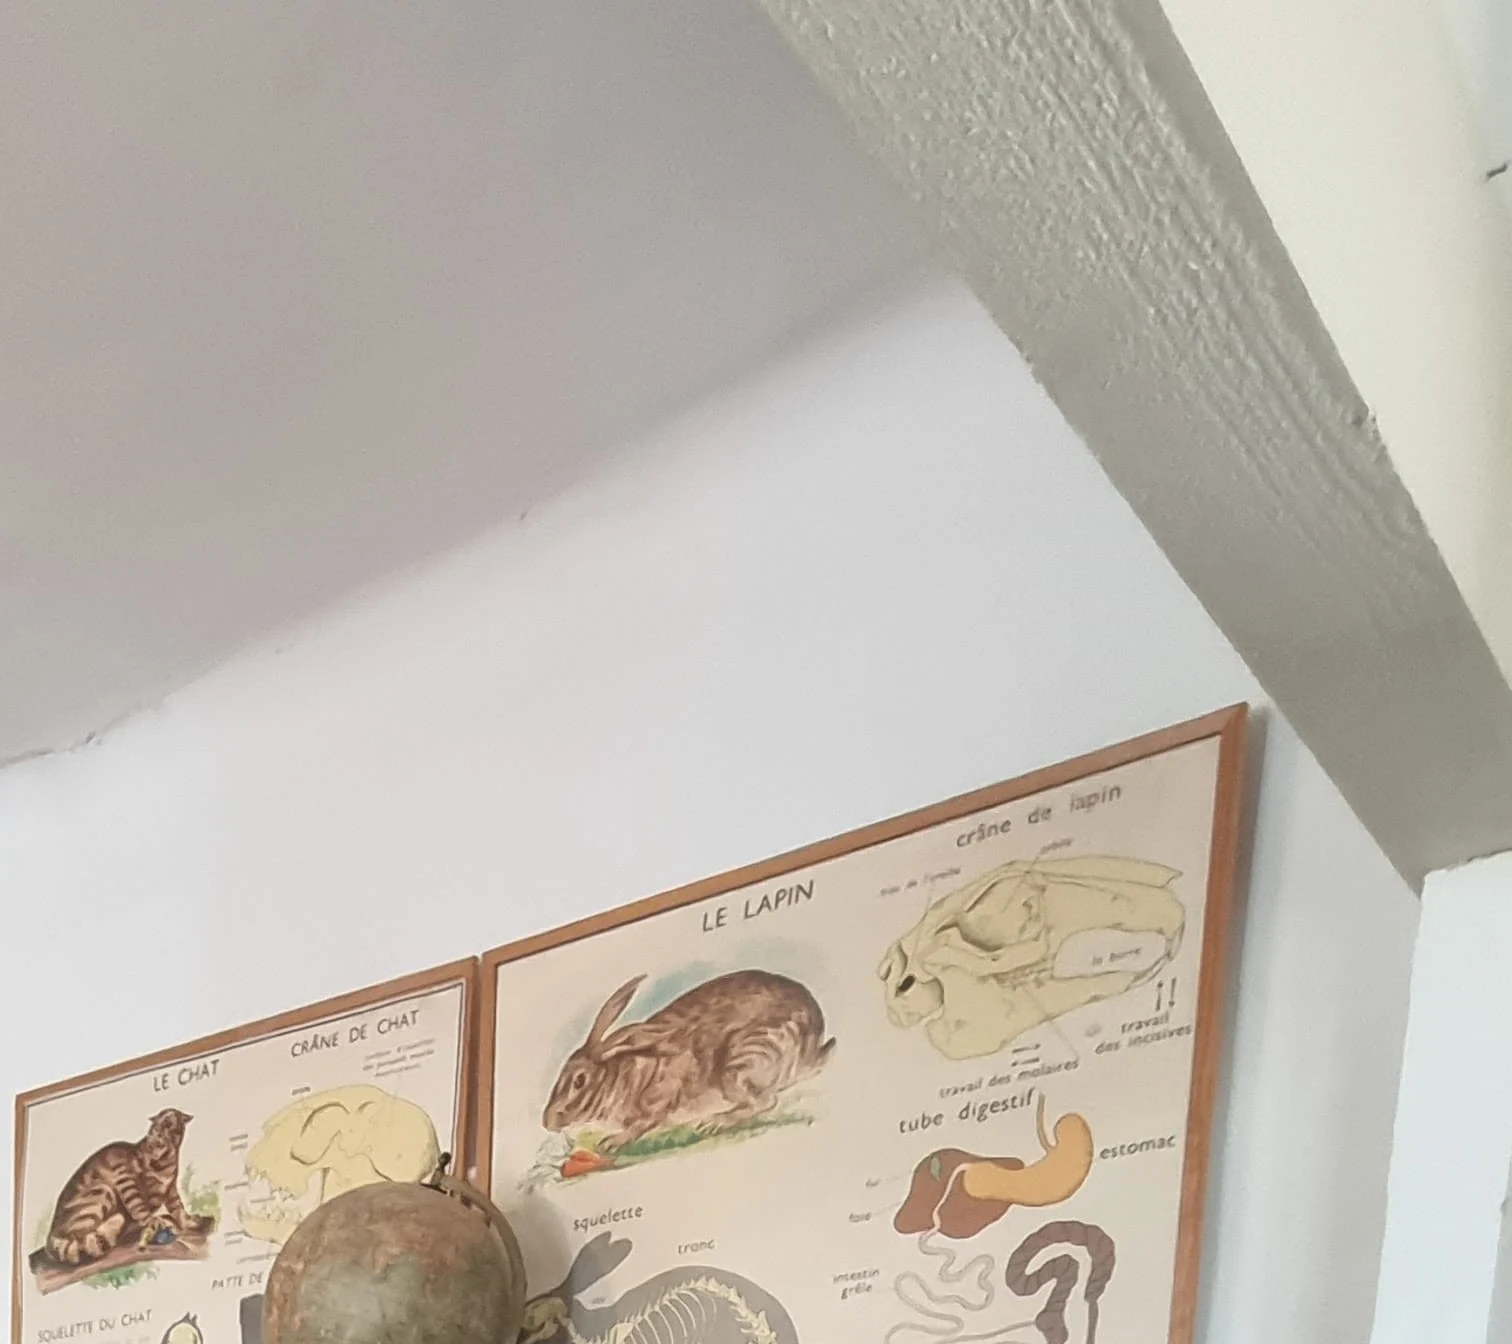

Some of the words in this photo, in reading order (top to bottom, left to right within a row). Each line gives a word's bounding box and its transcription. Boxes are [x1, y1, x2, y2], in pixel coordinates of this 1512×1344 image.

[956, 816, 1012, 848] crâne
[1027, 804, 1053, 825] de
[1069, 784, 1123, 815] lapin
[702, 907, 728, 933] LE
[743, 878, 815, 920] LAPIN
[290, 1027, 341, 1059] CRÂNE
[349, 1021, 369, 1043] DE
[377, 1009, 421, 1036] CHAT
[1121, 1011, 1171, 1034] travail
[1095, 1040, 1121, 1056] des
[1126, 1024, 1193, 1048] incisives
[153, 1073, 169, 1093] LE
[177, 1058, 221, 1089] CHAT
[939, 1077, 984, 1099] travail
[988, 1074, 1012, 1088] des
[1017, 1059, 1080, 1081] molaires
[898, 1110, 944, 1135] tube
[958, 1088, 1036, 1123] digestif
[1099, 1133, 1178, 1160] estomac
[572, 1205, 644, 1233] squelette
[678, 1239, 716, 1255] tronc
[211, 1273, 244, 1290] PATTE
[247, 1271, 265, 1285] DE
[832, 1268, 881, 1284] intestin
[37, 1317, 94, 1344] SQUELETTE
[99, 1315, 117, 1333] DU
[121, 1309, 154, 1328] CHAT
